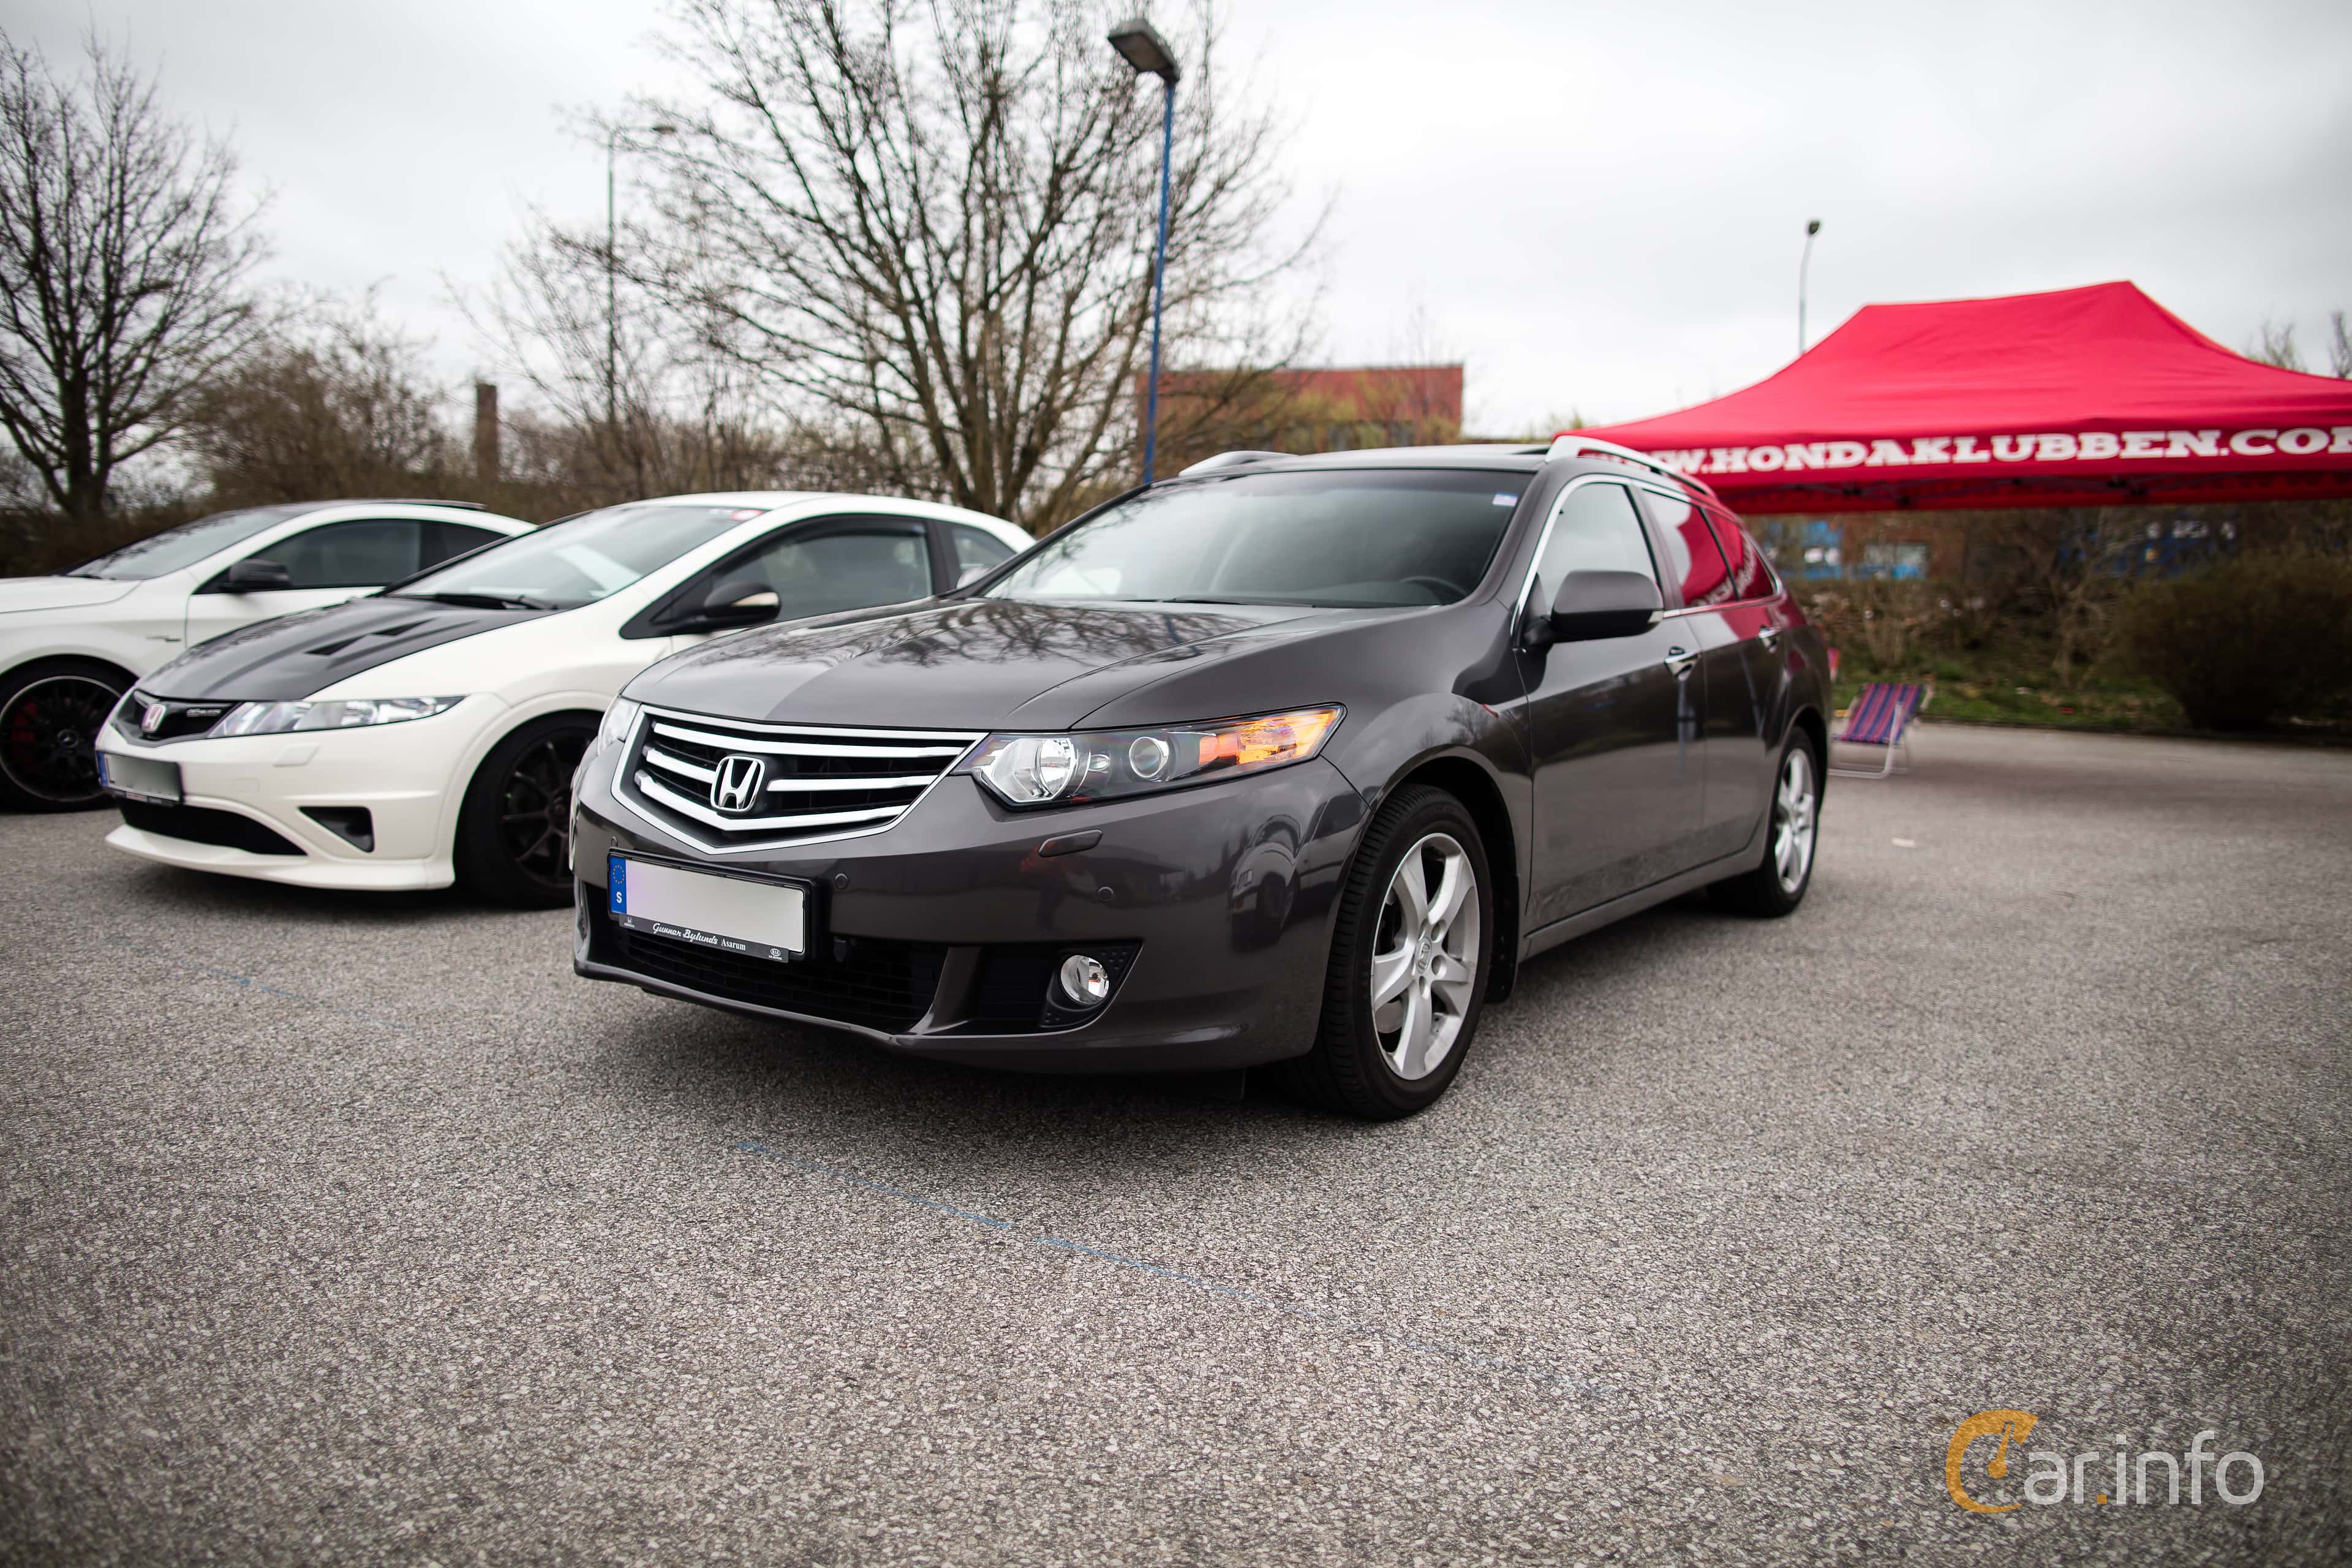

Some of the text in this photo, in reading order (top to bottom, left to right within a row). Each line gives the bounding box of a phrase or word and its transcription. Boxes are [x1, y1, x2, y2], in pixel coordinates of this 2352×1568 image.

[1583, 425, 2352, 475] W.HONDAKLUBBEN.CO
[616, 891, 622, 903] S
[652, 922, 746, 951] Gunnar Bylunds Asarum
